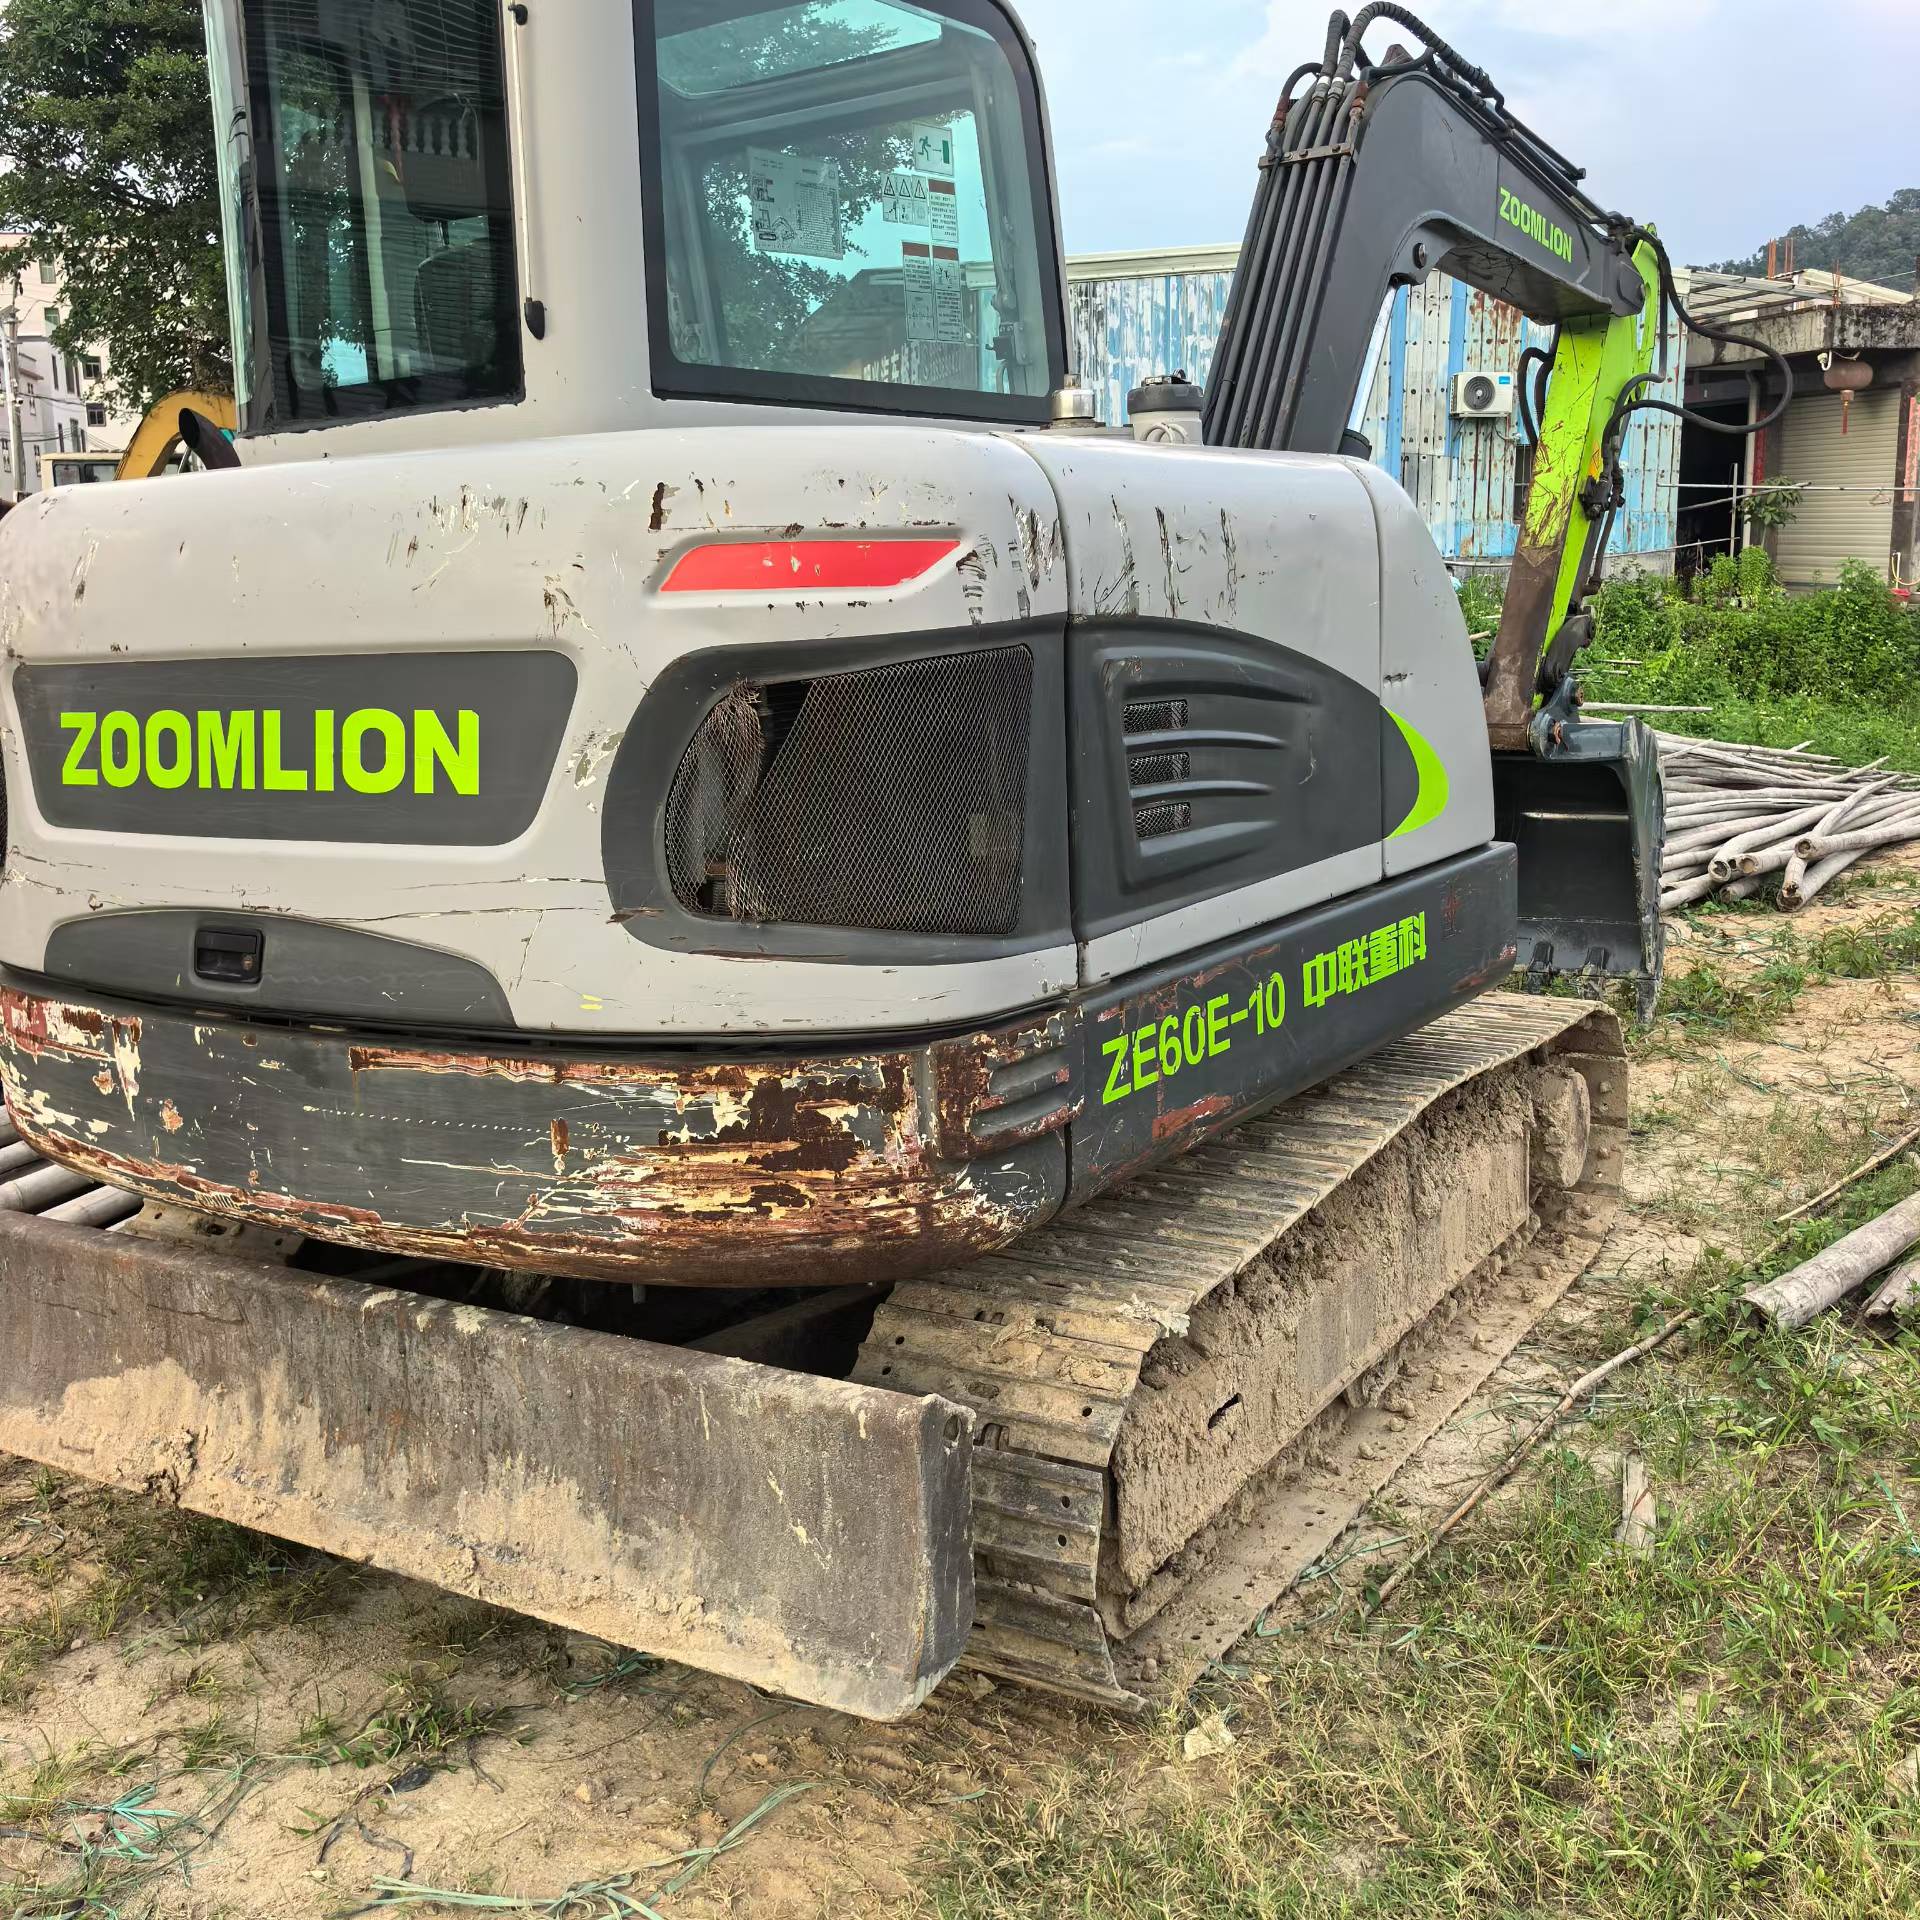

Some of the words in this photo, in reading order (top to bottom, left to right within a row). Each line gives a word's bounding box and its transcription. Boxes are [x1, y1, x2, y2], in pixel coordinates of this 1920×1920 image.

[1499, 187, 1573, 264] ZOOMLION
[59, 708, 479, 795] ZOOMLION
[1102, 972, 1286, 1105] ZE60E-10
[1303, 911, 1427, 1008] 中联重科
